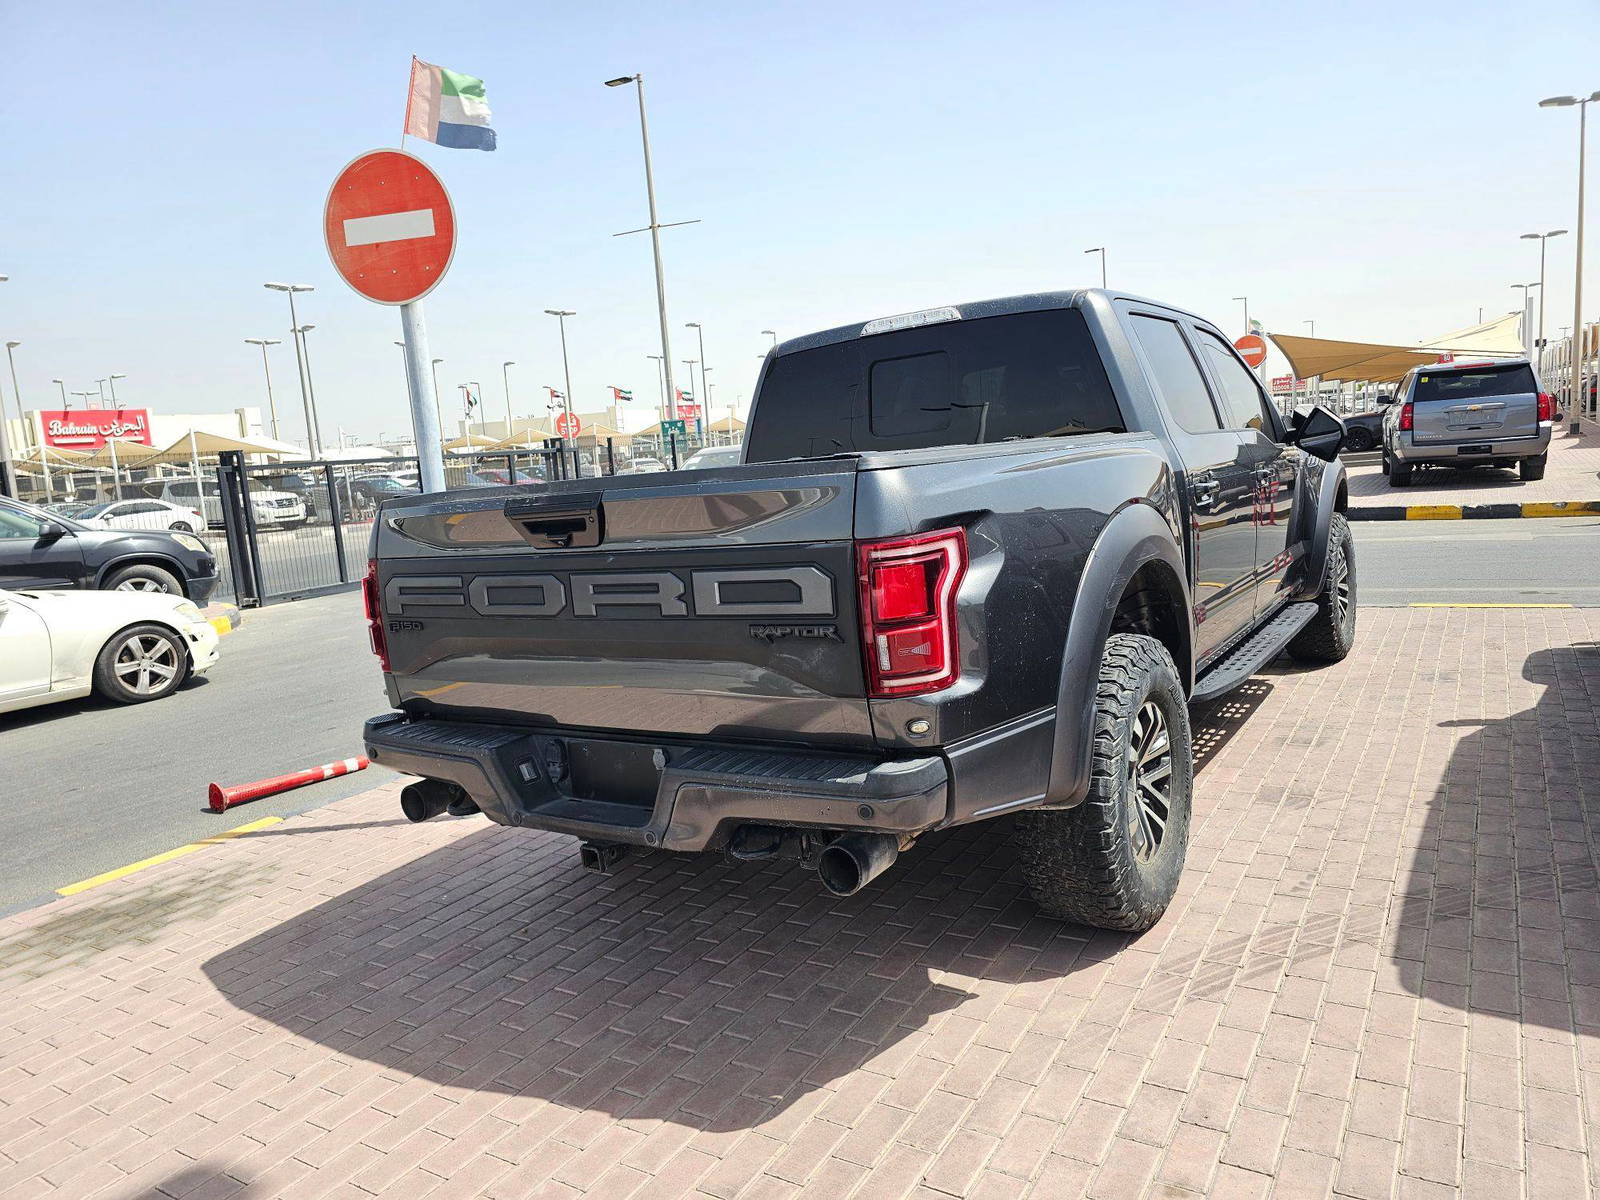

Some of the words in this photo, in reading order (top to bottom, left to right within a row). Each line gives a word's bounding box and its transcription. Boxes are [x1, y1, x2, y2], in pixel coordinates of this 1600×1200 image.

[48, 420, 98, 436] Bahrain
[98, 415, 145, 437] البحرين
[384, 566, 836, 618] FORD
[749, 624, 844, 643] RAPTOR
